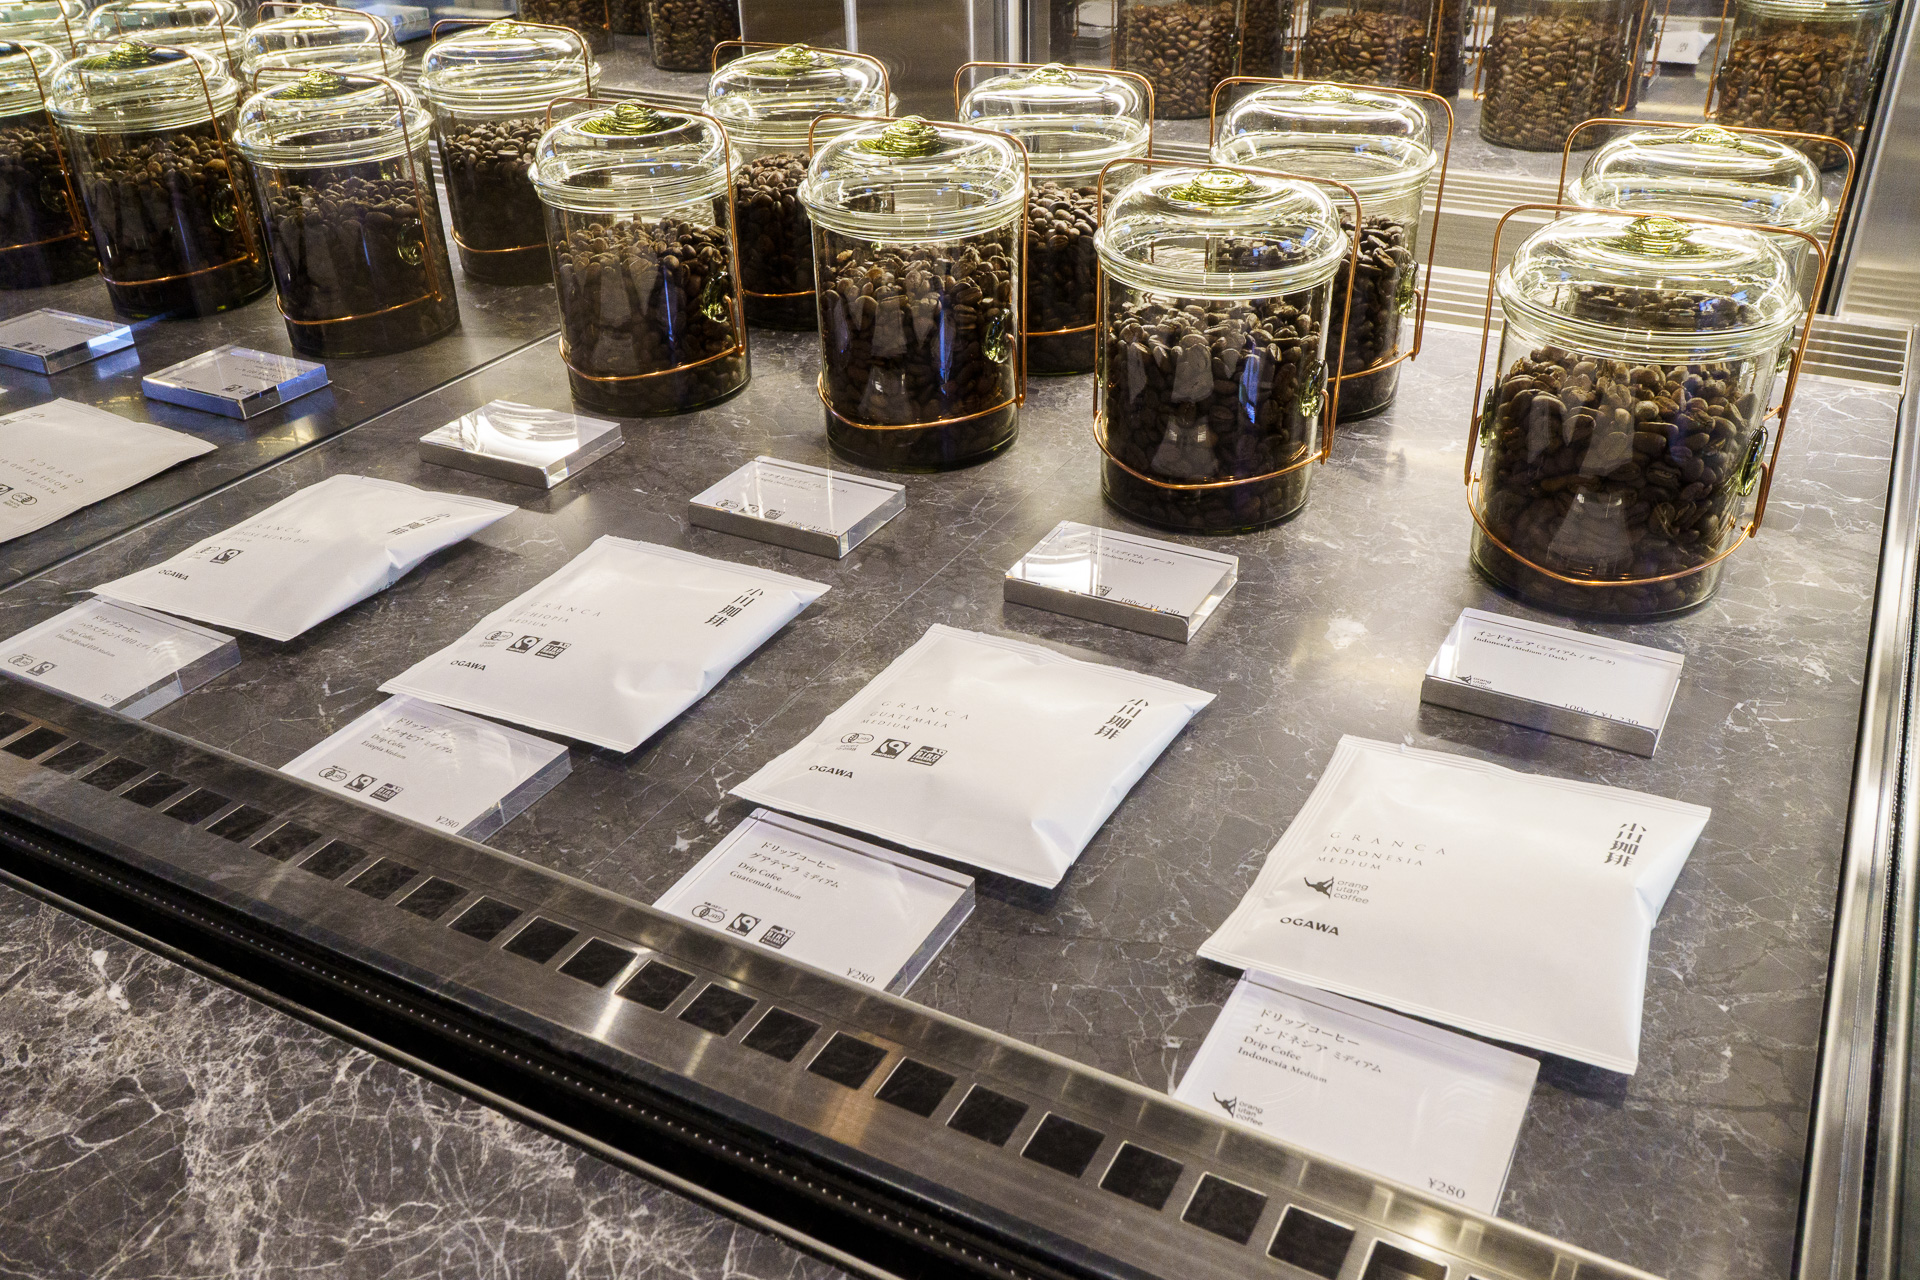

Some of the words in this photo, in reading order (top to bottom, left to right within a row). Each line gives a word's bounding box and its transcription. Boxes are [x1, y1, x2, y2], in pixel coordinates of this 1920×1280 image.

[158, 569, 189, 581] OGAWA
[530, 602, 601, 617] GRANCA
[704, 588, 764, 628] 小川珈琲
[1473, 636, 1511, 649] Indonesia
[450, 660, 487, 671] OGAWA
[881, 701, 969, 720] GRANCA
[860, 719, 911, 730] MEDIUM
[869, 711, 948, 728] GUATEMALA
[1094, 699, 1149, 740] 小川珈琲
[371, 733, 387, 743] Drip
[809, 765, 853, 779] OGAWA
[435, 815, 460, 829] ¥280
[1330, 832, 1445, 855] GRANCA
[1604, 823, 1647, 867] 小川珈琲
[761, 841, 836, 870] ドリップコーヒー
[1317, 856, 1381, 870] MEDIUM
[1322, 846, 1423, 866] INDONESIA
[738, 862, 757, 874] Drip
[749, 852, 800, 873] グアテマラ
[803, 871, 839, 888] ミディアム
[729, 870, 772, 890] Guatemala
[773, 886, 801, 900] Medium
[1336, 886, 1360, 895] utan
[1337, 880, 1369, 891] orang
[1333, 892, 1369, 904] coffee
[1280, 917, 1339, 936] OGAWA
[847, 967, 875, 984] ¥280
[1261, 1009, 1360, 1046] ドリップコーヒー
[1243, 1036, 1268, 1051] Drip
[1253, 1024, 1328, 1052] インドネシア
[1333, 1051, 1382, 1073] ミディアム
[1238, 1047, 1288, 1070] Indonesia
[1290, 1066, 1327, 1083] Medium
[1238, 1107, 1257, 1117] utan
[1239, 1101, 1263, 1114] orang
[1236, 1114, 1263, 1126] coffee
[1428, 1177, 1466, 1199] ¥280
